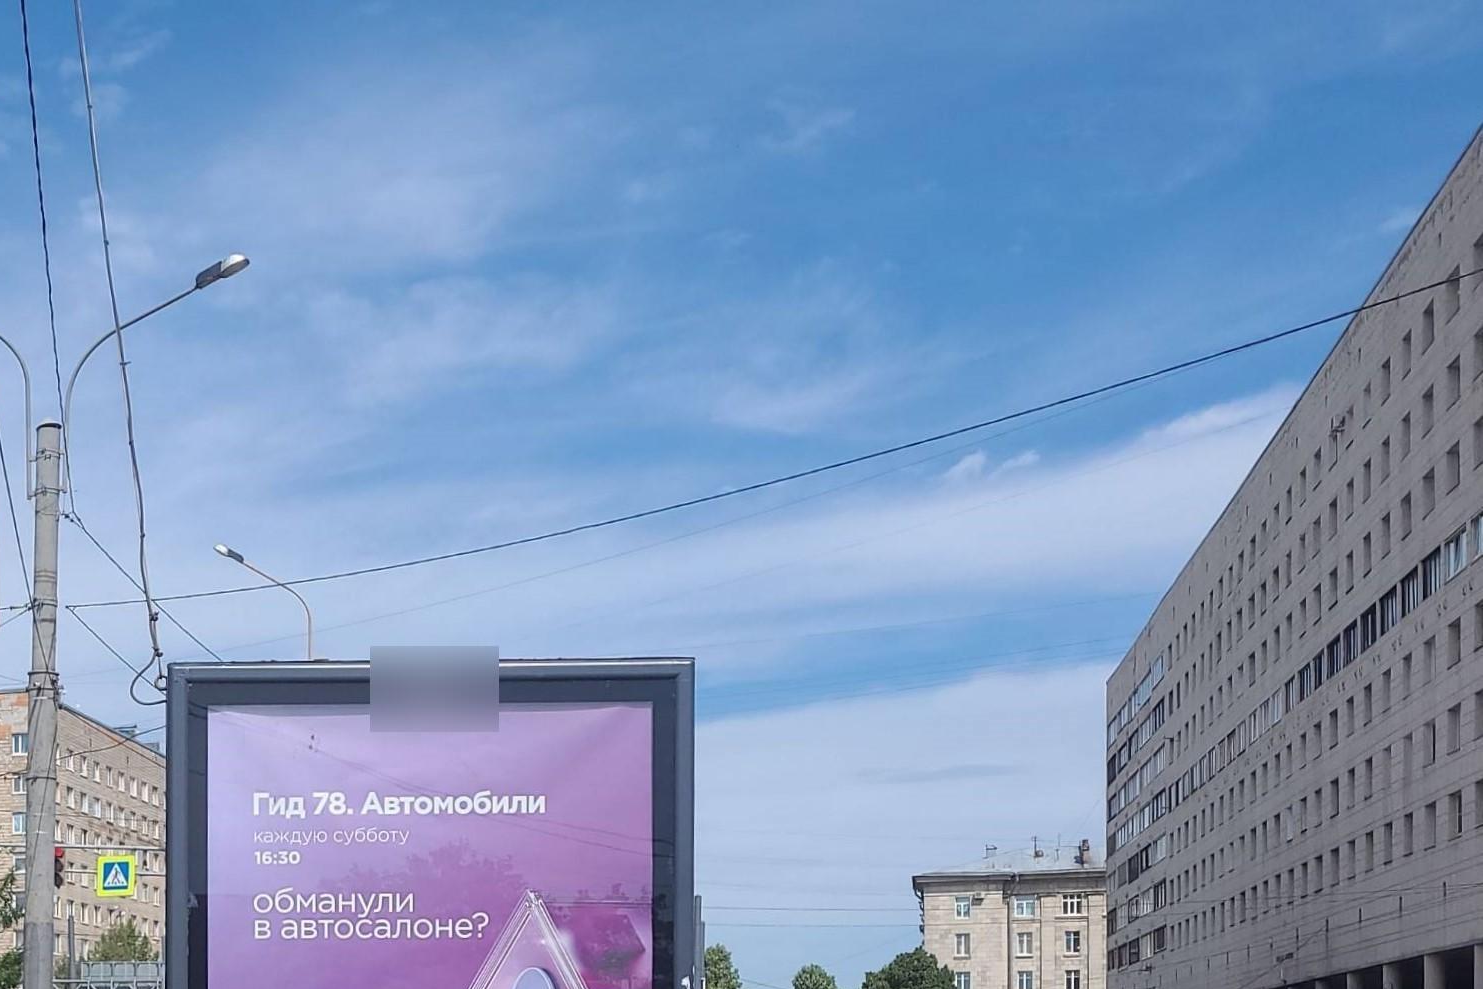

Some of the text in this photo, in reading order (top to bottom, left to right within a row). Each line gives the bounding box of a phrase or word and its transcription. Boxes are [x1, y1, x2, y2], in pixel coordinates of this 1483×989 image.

[252, 789, 547, 819] Гид 78. Автомобили
[253, 827, 410, 846] каждую субботу
[254, 851, 301, 866] 16:30
[252, 887, 415, 918] обманули
[254, 912, 490, 940] в автосалоне?
